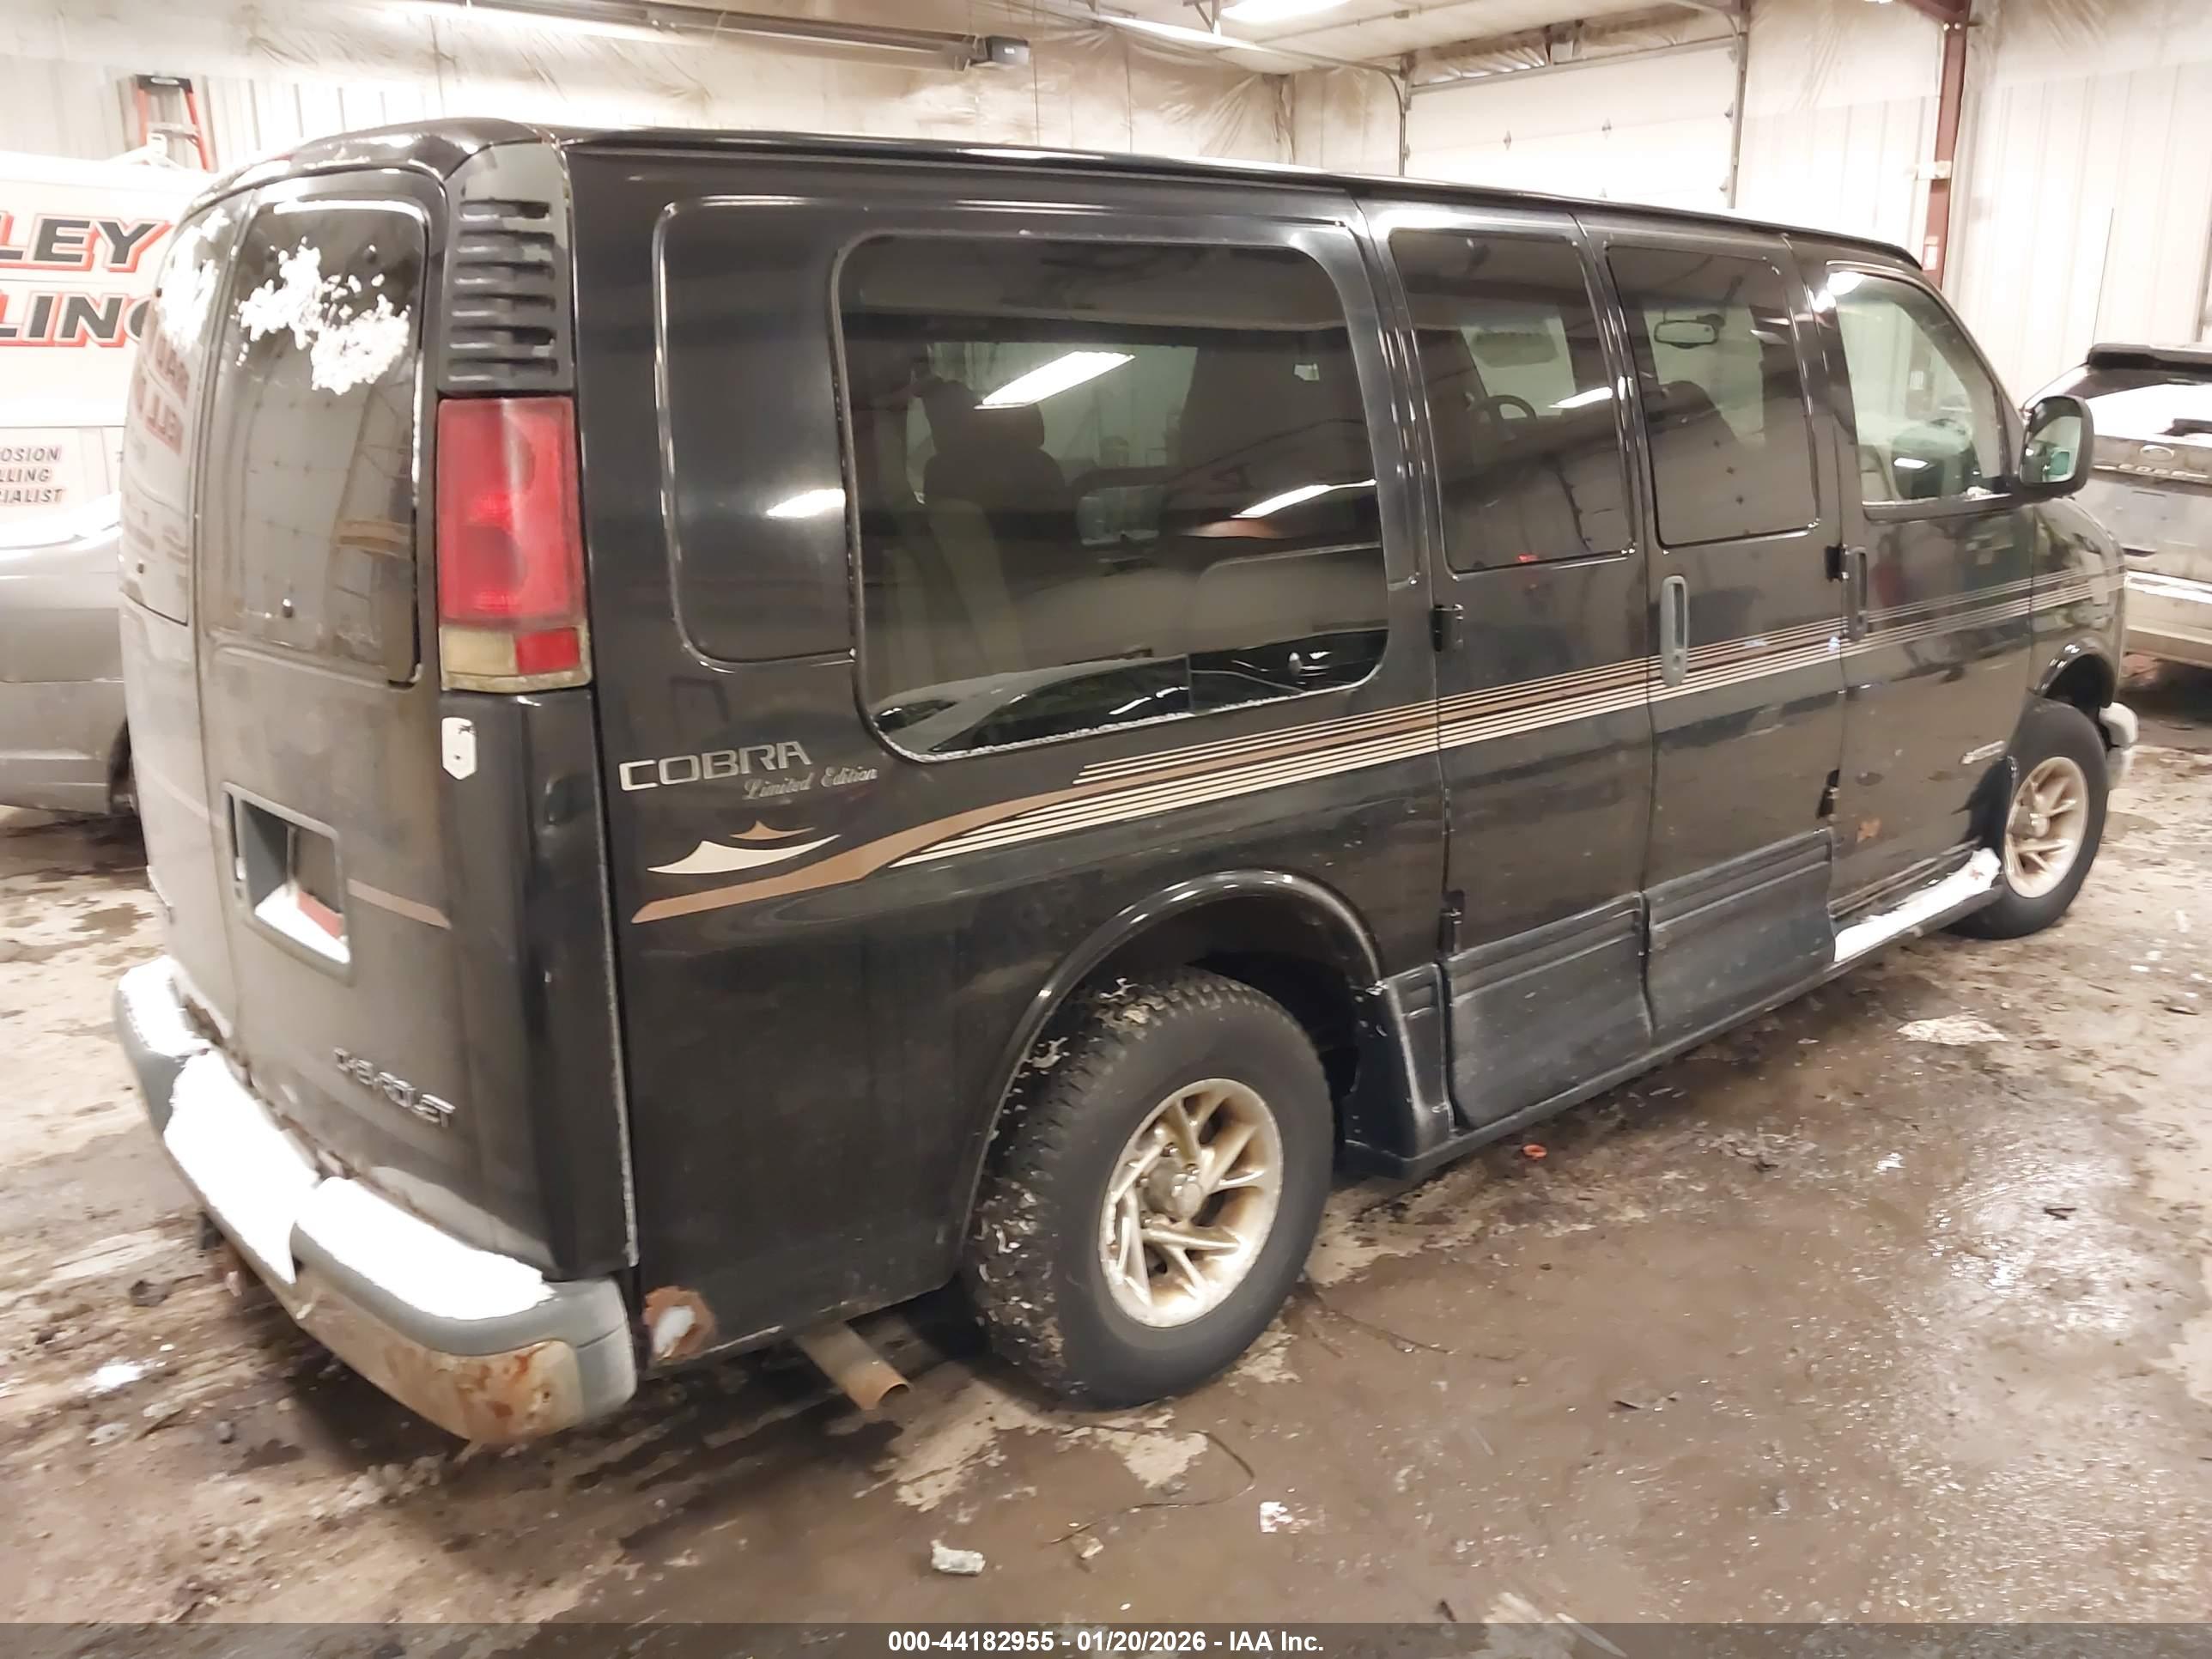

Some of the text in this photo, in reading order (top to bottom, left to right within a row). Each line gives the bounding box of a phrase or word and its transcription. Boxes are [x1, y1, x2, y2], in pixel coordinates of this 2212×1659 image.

[0, 488, 63, 504] IALIST
[619, 741, 812, 791] COBRA
[742, 766, 878, 800] Limited Edition
